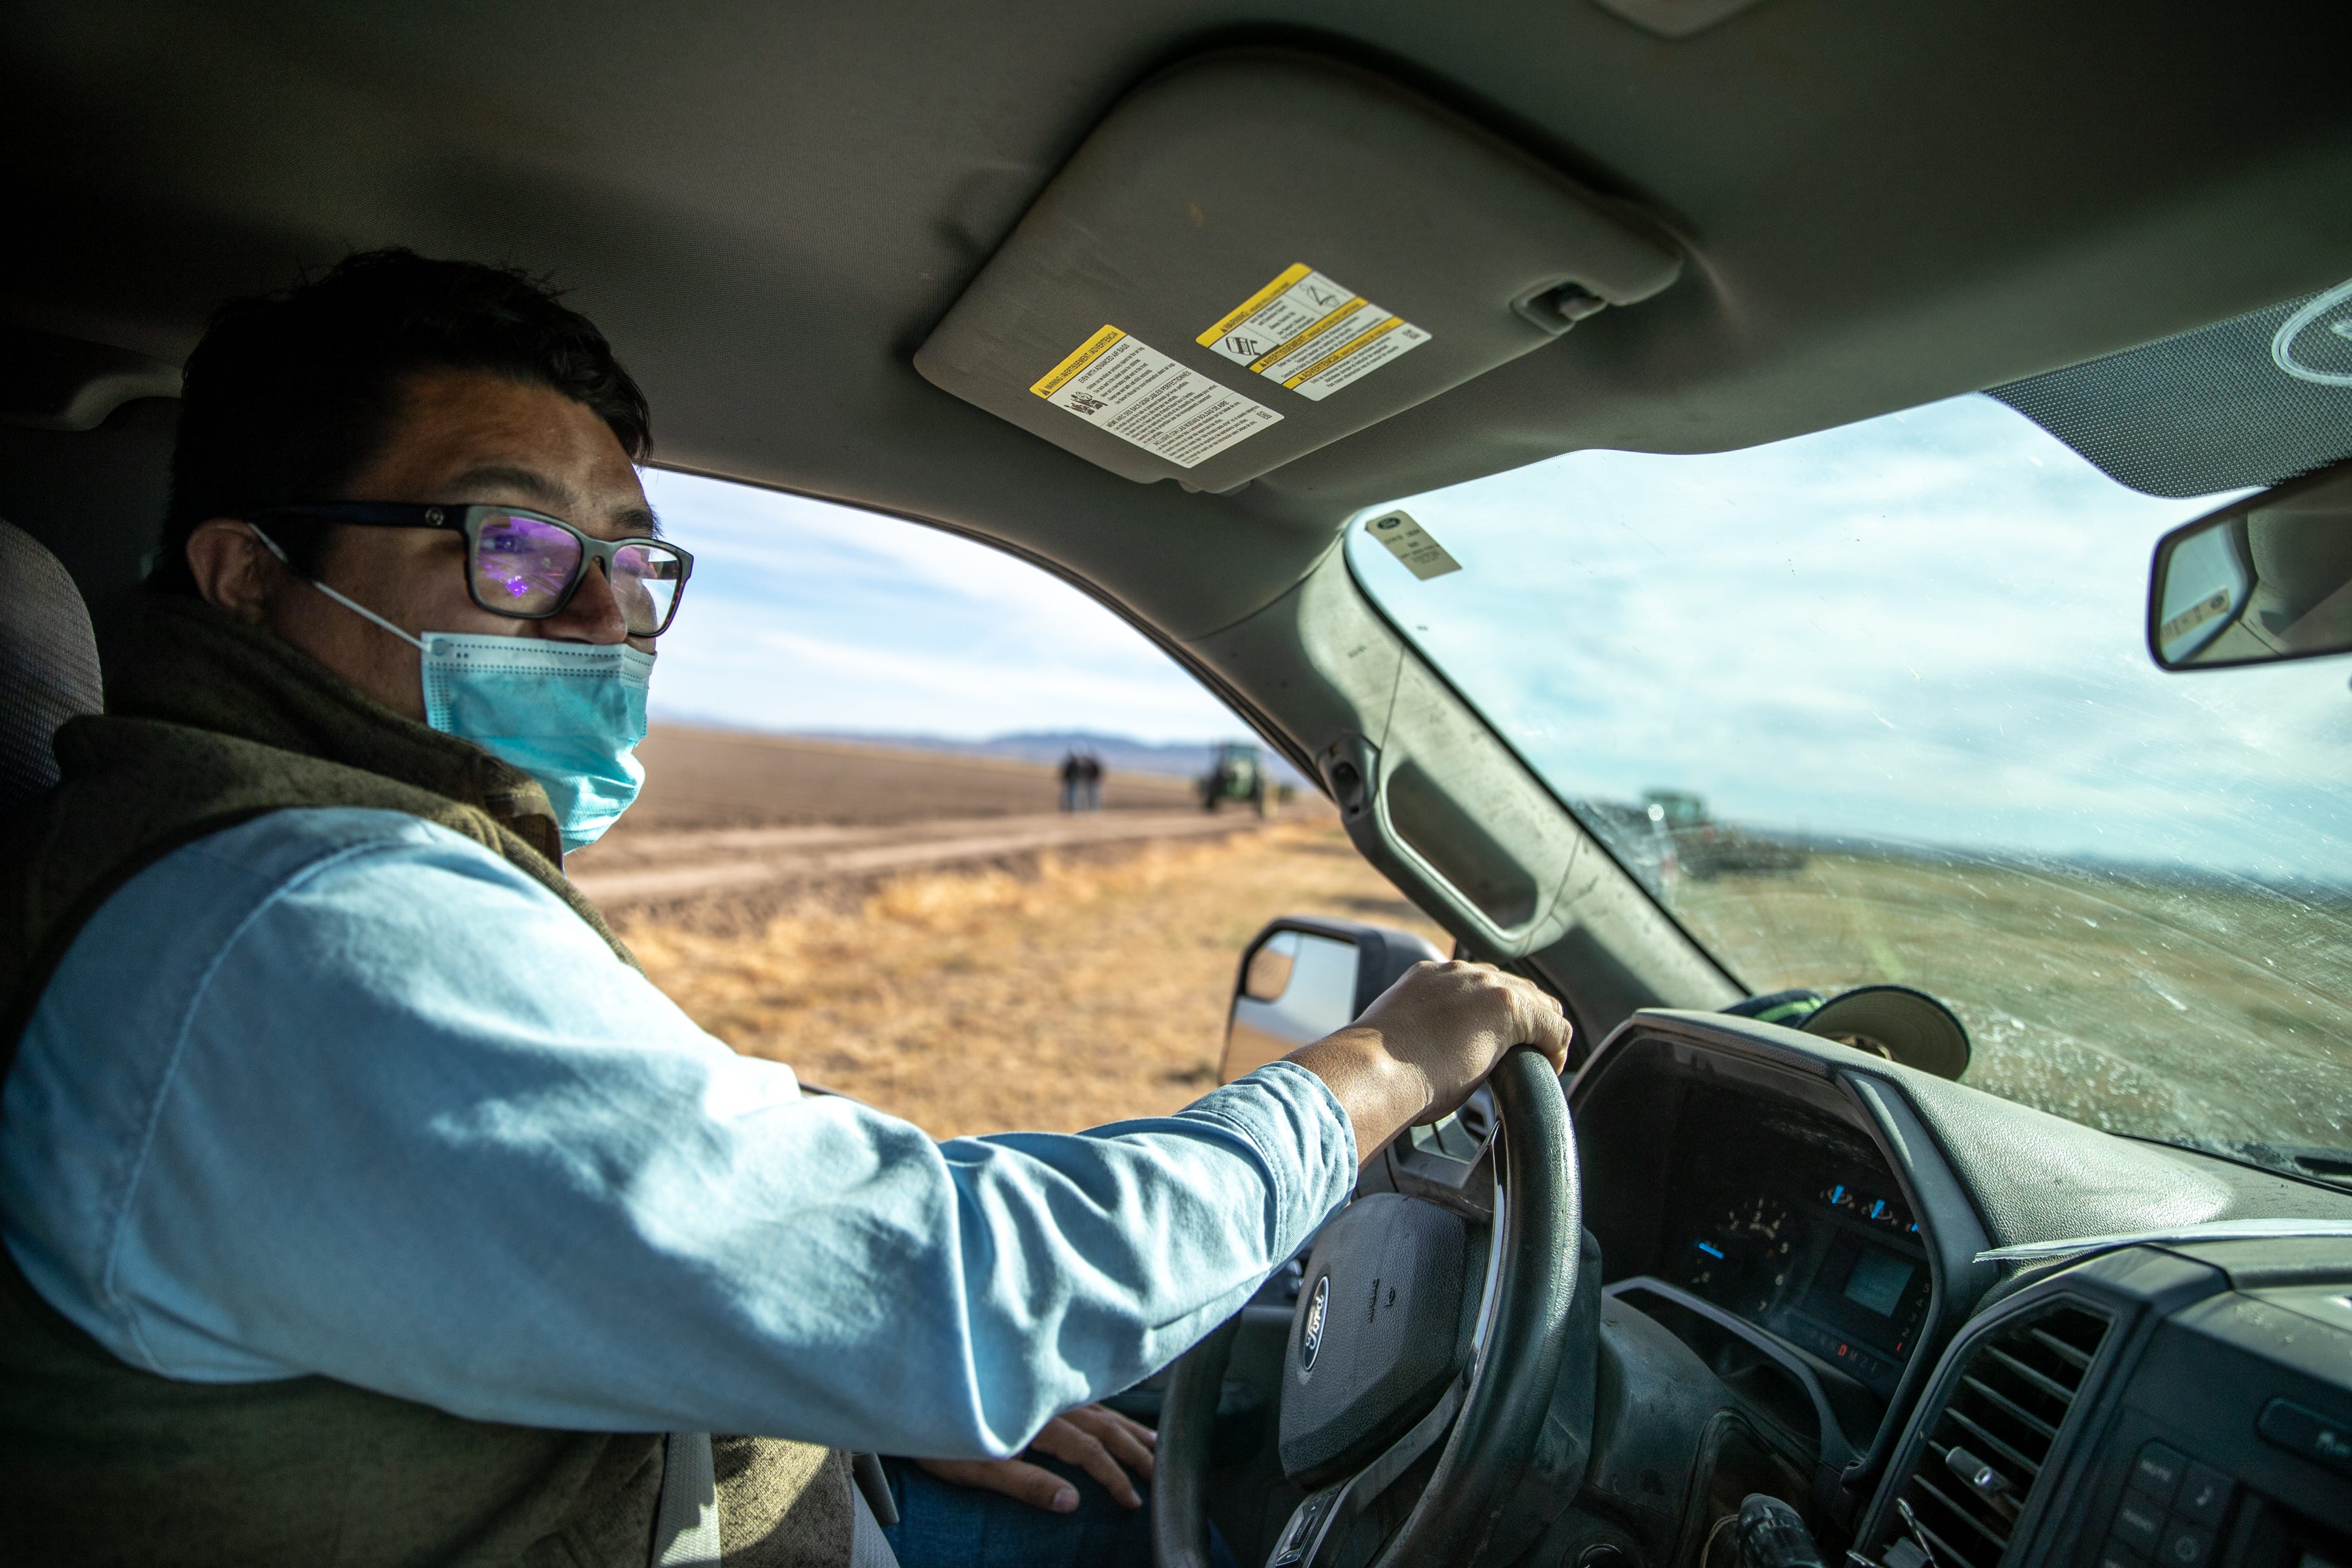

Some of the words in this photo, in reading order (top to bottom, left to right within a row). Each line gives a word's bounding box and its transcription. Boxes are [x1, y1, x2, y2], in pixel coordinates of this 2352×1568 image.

[1224, 311, 1249, 329] WARNING:
[1077, 375, 1090, 384] EVEN
[1085, 368, 1098, 377] WITH
[1094, 355, 1115, 371] ADVANCED
[1116, 343, 1130, 353] BAGS
[1263, 335, 1305, 365] AVERTISSEMENT:
[1301, 355, 1340, 378] ADVERTENCIA:
[1044, 376, 1064, 390] WARNING
[1106, 419, 1119, 428] MÊME
[1129, 403, 1142, 412] SACS
[1138, 389, 1164, 406] GONFLABLES
[1160, 370, 1192, 391] PERFECTIONNÉS
[1152, 434, 1173, 446] INCLUSIVE
[1183, 417, 1200, 427] NUEVAS
[1196, 408, 1215, 419] BOLSAS
[1217, 400, 1230, 408] AIRE
[1367, 1279, 1379, 1323] AIRBAG
[1306, 1295, 1324, 1350] Ford
